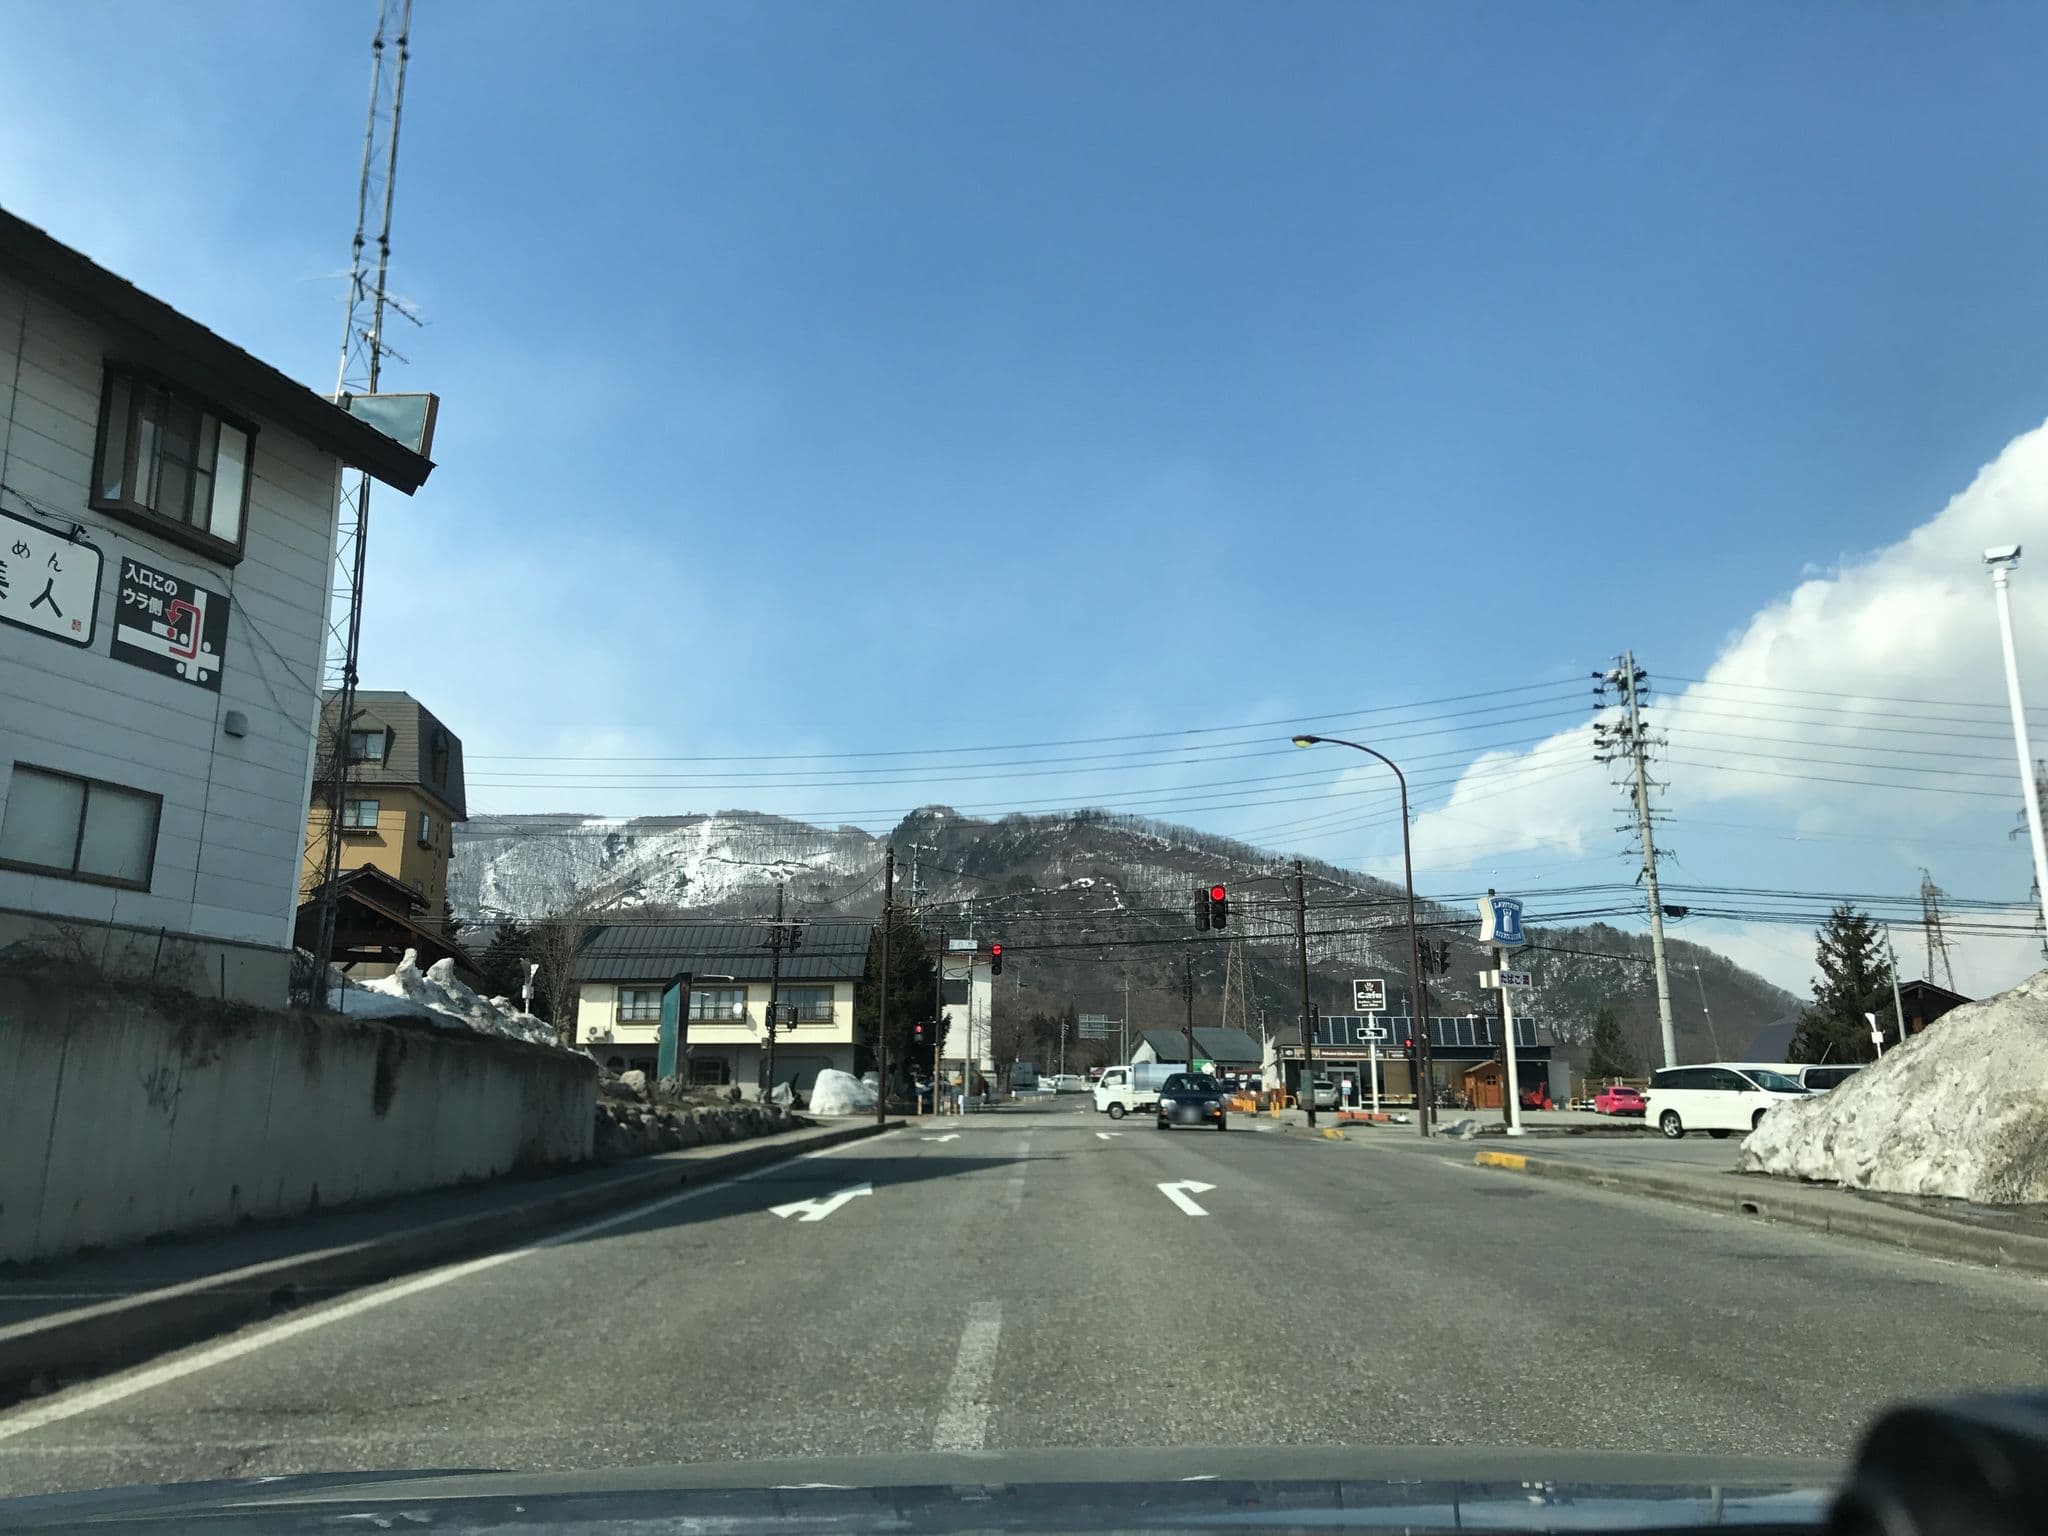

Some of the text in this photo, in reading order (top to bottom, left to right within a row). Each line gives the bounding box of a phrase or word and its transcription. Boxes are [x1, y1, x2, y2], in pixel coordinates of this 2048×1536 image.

[12, 539, 62, 572] めん
[125, 563, 178, 596] 入口この
[123, 588, 163, 616] ウラ側
